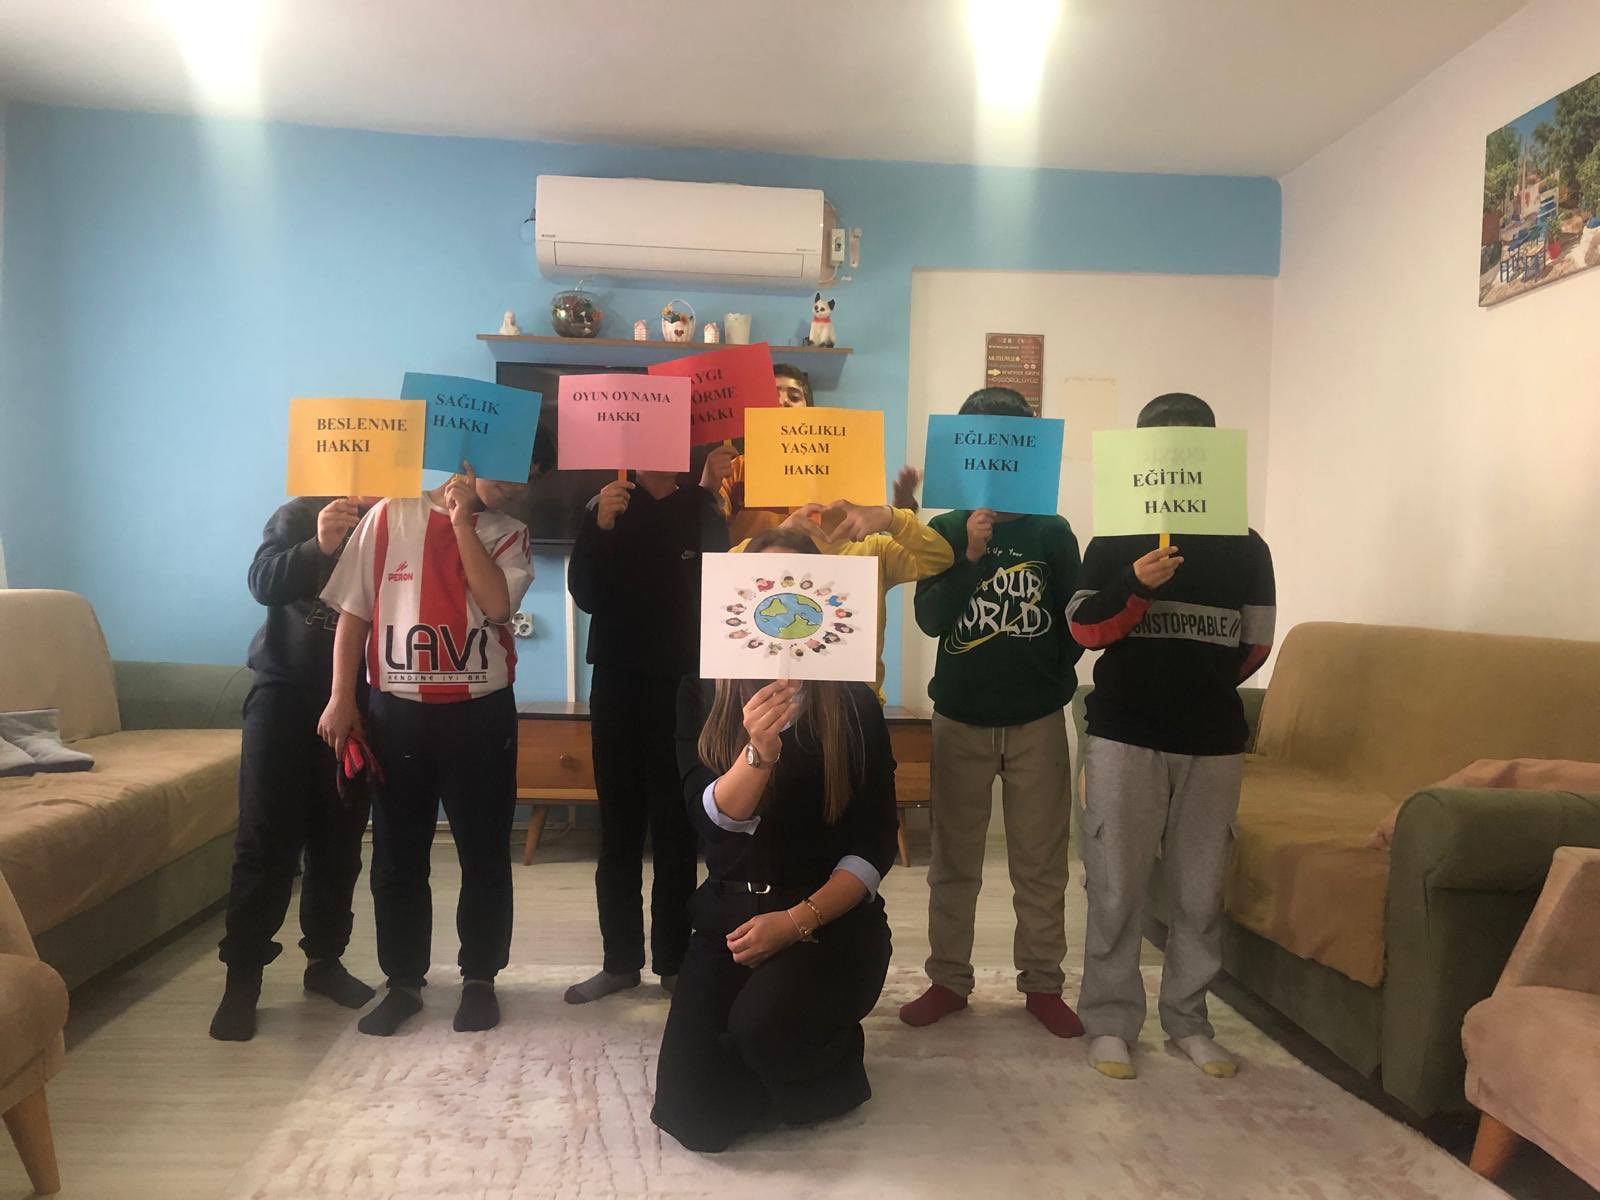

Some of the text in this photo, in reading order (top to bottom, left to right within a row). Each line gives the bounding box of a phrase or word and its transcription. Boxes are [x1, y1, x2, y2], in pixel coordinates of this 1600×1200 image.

[688, 369, 722, 384] AYGI
[435, 393, 500, 416] SAĞLIK
[572, 391, 671, 403] OYUN OYNAMA
[316, 417, 408, 432] BESLENME
[597, 412, 640, 422] HAKKI
[433, 415, 489, 435] HAKKI
[780, 422, 847, 437] SAĞLIKLI
[316, 439, 370, 453] HAKKI
[954, 430, 1036, 448] EĞLENME
[781, 442, 829, 455] YAŞAM
[784, 465, 829, 475] HAKKI
[964, 458, 1018, 472] HAKKI
[1133, 468, 1202, 487] EĞİTİM
[1145, 499, 1206, 514] HAKKI
